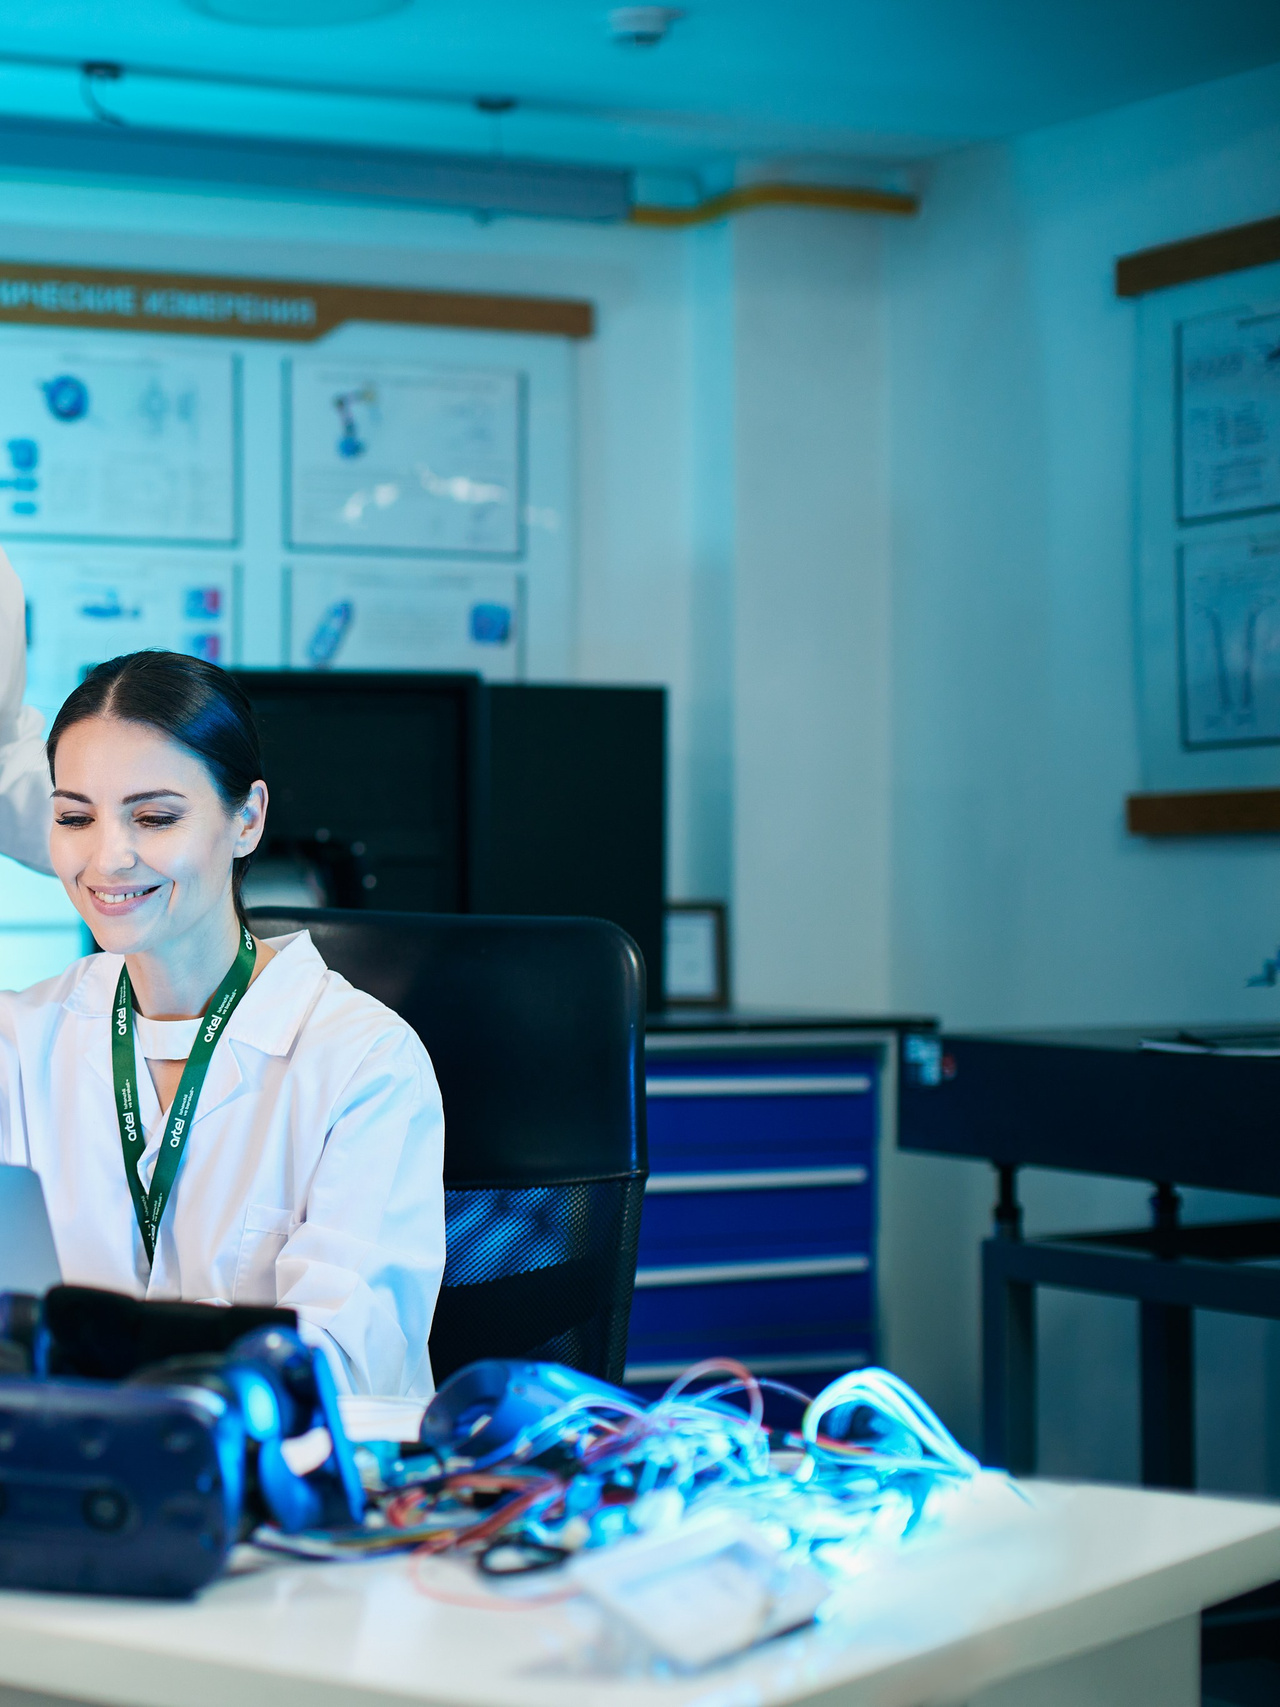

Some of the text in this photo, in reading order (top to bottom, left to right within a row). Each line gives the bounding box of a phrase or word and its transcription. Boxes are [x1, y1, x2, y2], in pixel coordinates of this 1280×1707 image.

[116, 1007, 127, 1036] artel
[204, 1014, 223, 1043] artel
[122, 1112, 137, 1142] artel
[170, 1117, 185, 1148] artel
